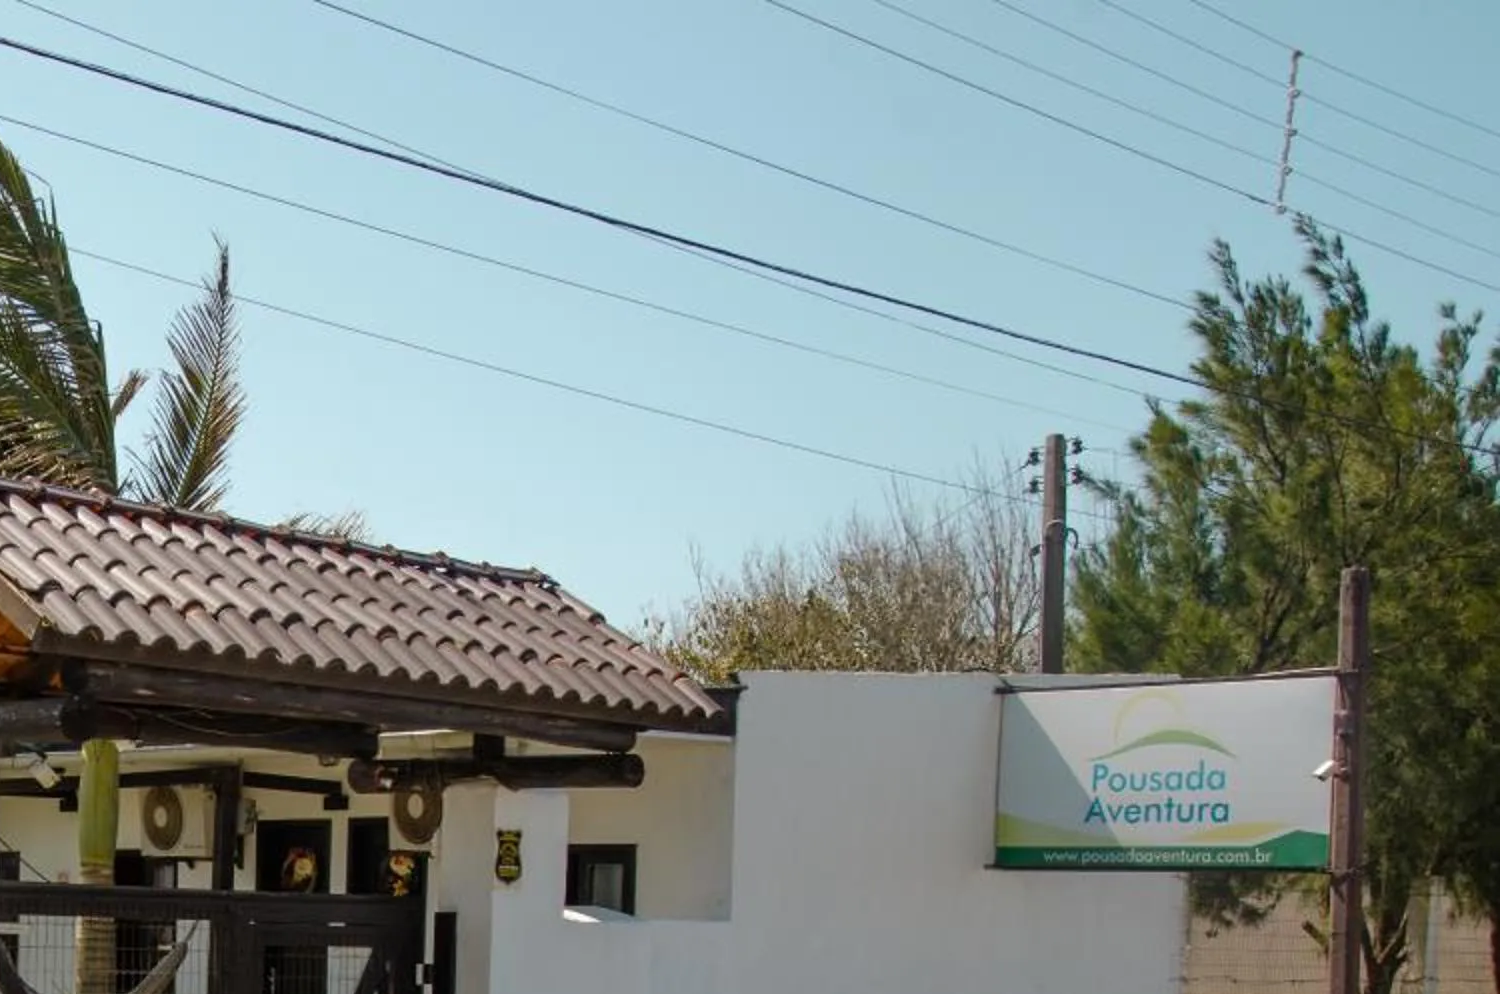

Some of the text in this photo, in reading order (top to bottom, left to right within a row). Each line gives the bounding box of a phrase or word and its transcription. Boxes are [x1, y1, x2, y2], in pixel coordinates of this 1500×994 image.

[1091, 760, 1227, 793] Pousada
[1083, 796, 1230, 824] Aventura
[1043, 848, 1273, 865] www.pousadaaventura.com.br
